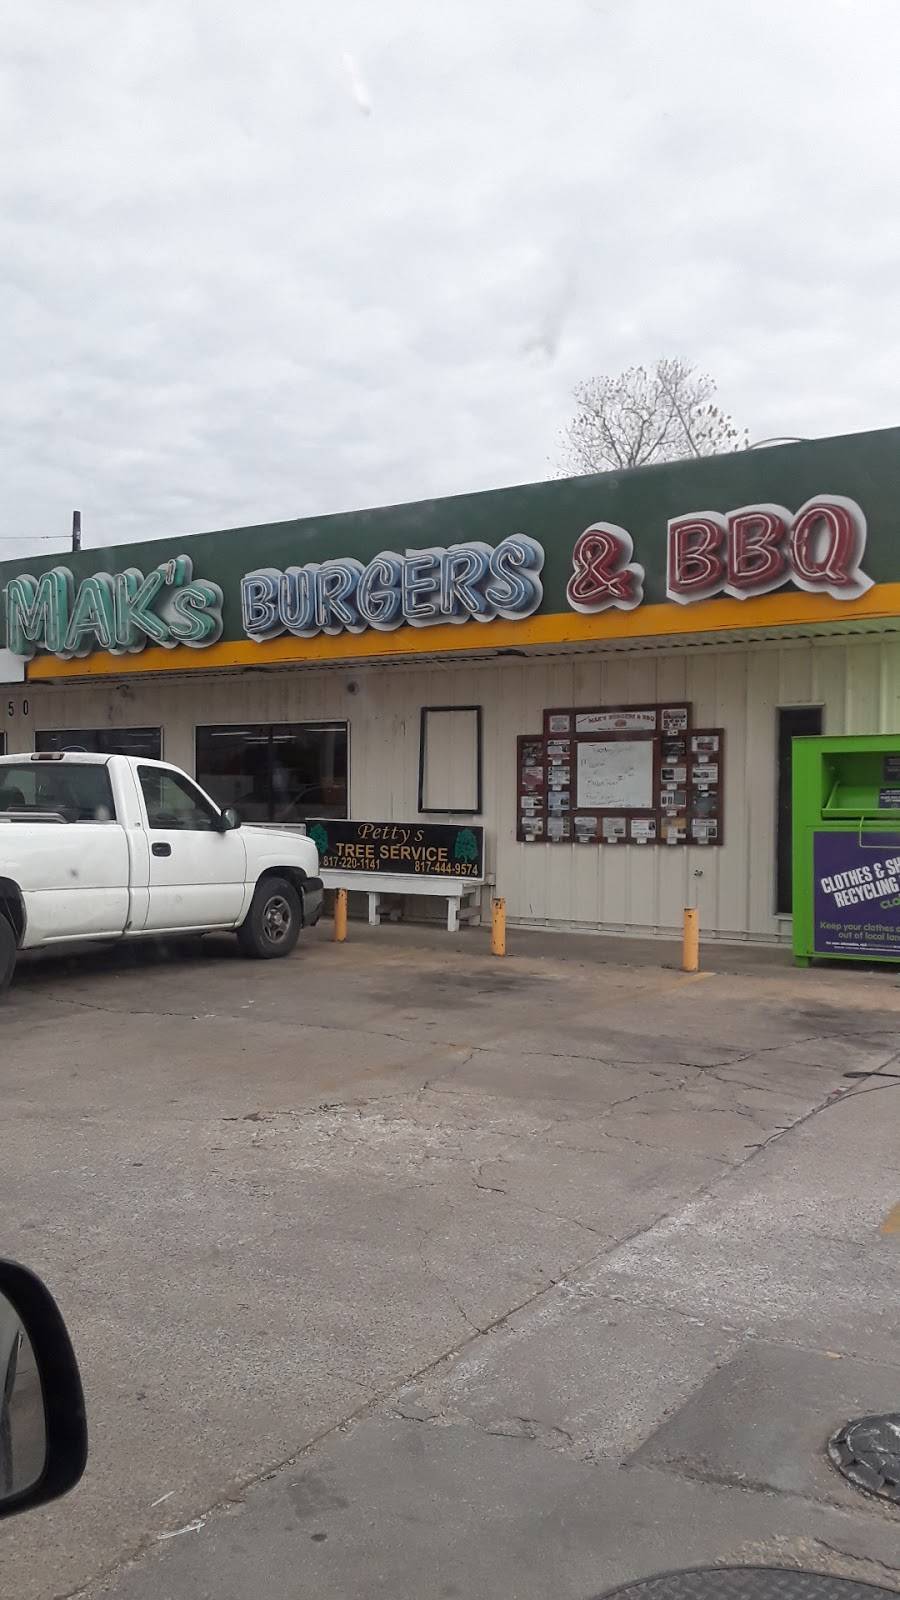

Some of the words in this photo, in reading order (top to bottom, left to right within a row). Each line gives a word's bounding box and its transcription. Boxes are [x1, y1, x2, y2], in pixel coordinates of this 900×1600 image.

[240, 537, 541, 636] BURGERS
[567, 526, 641, 609] &
[668, 498, 864, 600] BBQ
[358, 823, 411, 846] Petty
[335, 842, 375, 858] TREE
[379, 845, 449, 862] SERVICE
[323, 856, 380, 871] 817-220-1141
[414, 860, 479, 876] 817-444-9574
[820, 866, 873, 893] CLOTHES
[873, 862, 885, 878] &
[833, 876, 900, 908] RECYCLING
[820, 921, 842, 932] Keep
[843, 923, 861, 932] your
[863, 923, 894, 933] clothes
[838, 931, 852, 939] out
[854, 931, 864, 939] of
[865, 931, 885, 940] local
